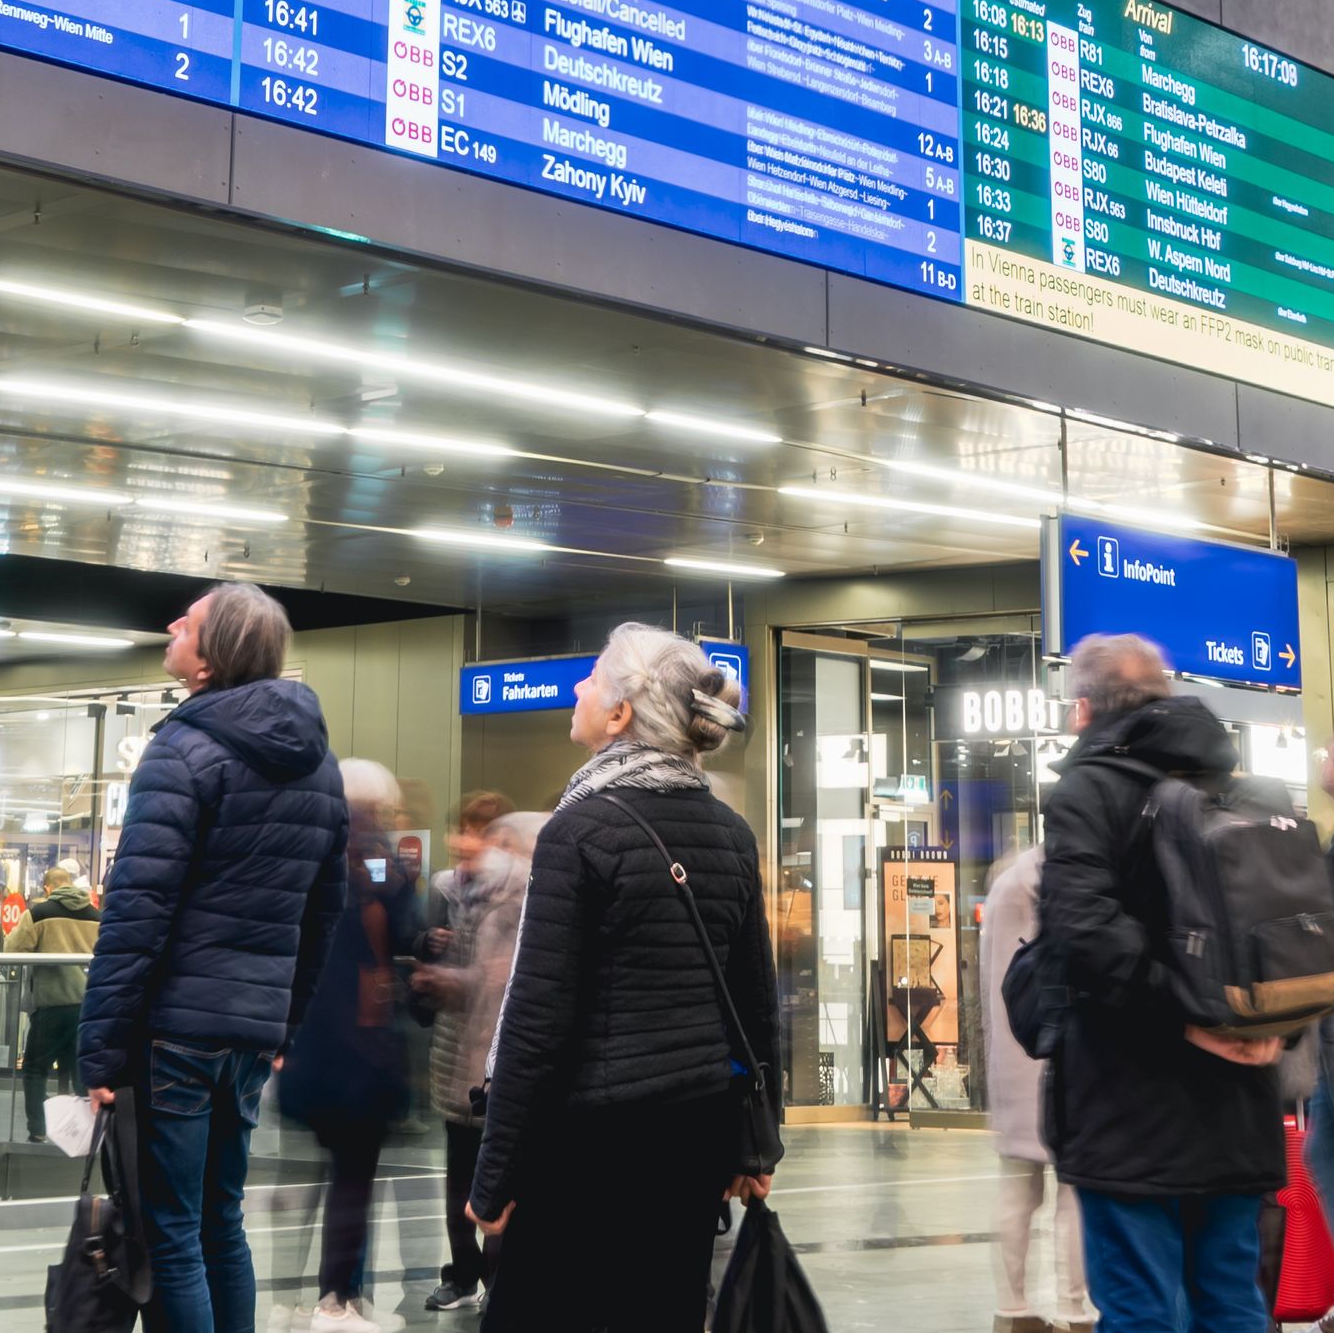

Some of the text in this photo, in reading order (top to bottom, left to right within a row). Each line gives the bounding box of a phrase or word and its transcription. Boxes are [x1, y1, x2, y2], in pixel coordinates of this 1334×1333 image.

[544, 7, 673, 71] Flughafen Wien
[1010, 12, 1045, 42] 16:13
[1079, 38, 1102, 65] R81
[544, 44, 663, 104] Deutschkreutz
[1080, 68, 1114, 99] REX6
[261, 76, 318, 115] 16:42
[543, 80, 610, 128] Mödling
[1142, 92, 1245, 149] Bratislava-Petrzalka
[440, 125, 497, 164] EC 149
[542, 117, 627, 169] Marchegg
[917, 132, 954, 163] 12 A-B
[541, 153, 647, 206] Zahony Kyiv
[1144, 149, 1227, 197] Budapest Keleti
[977, 214, 1012, 243] 16:37
[1146, 208, 1221, 251] Innsbruck Hbf
[971, 282, 1094, 329] at the train station!
[971, 246, 984, 270] In
[987, 251, 1035, 285] Vienna
[1039, 271, 1113, 307] passengers
[1116, 294, 1147, 317] must
[1151, 305, 1179, 325] wear
[1182, 313, 1197, 330] an
[1200, 313, 1231, 342] FFP2
[1234, 329, 1263, 350] mask
[1266, 339, 1281, 355] on
[1283, 344, 1314, 367] public
[1123, 558, 1176, 587] InfoPoint
[1205, 640, 1244, 666] Tickets
[502, 683, 558, 701] Fahrkarten
[503, 672, 524, 682] Tickets
